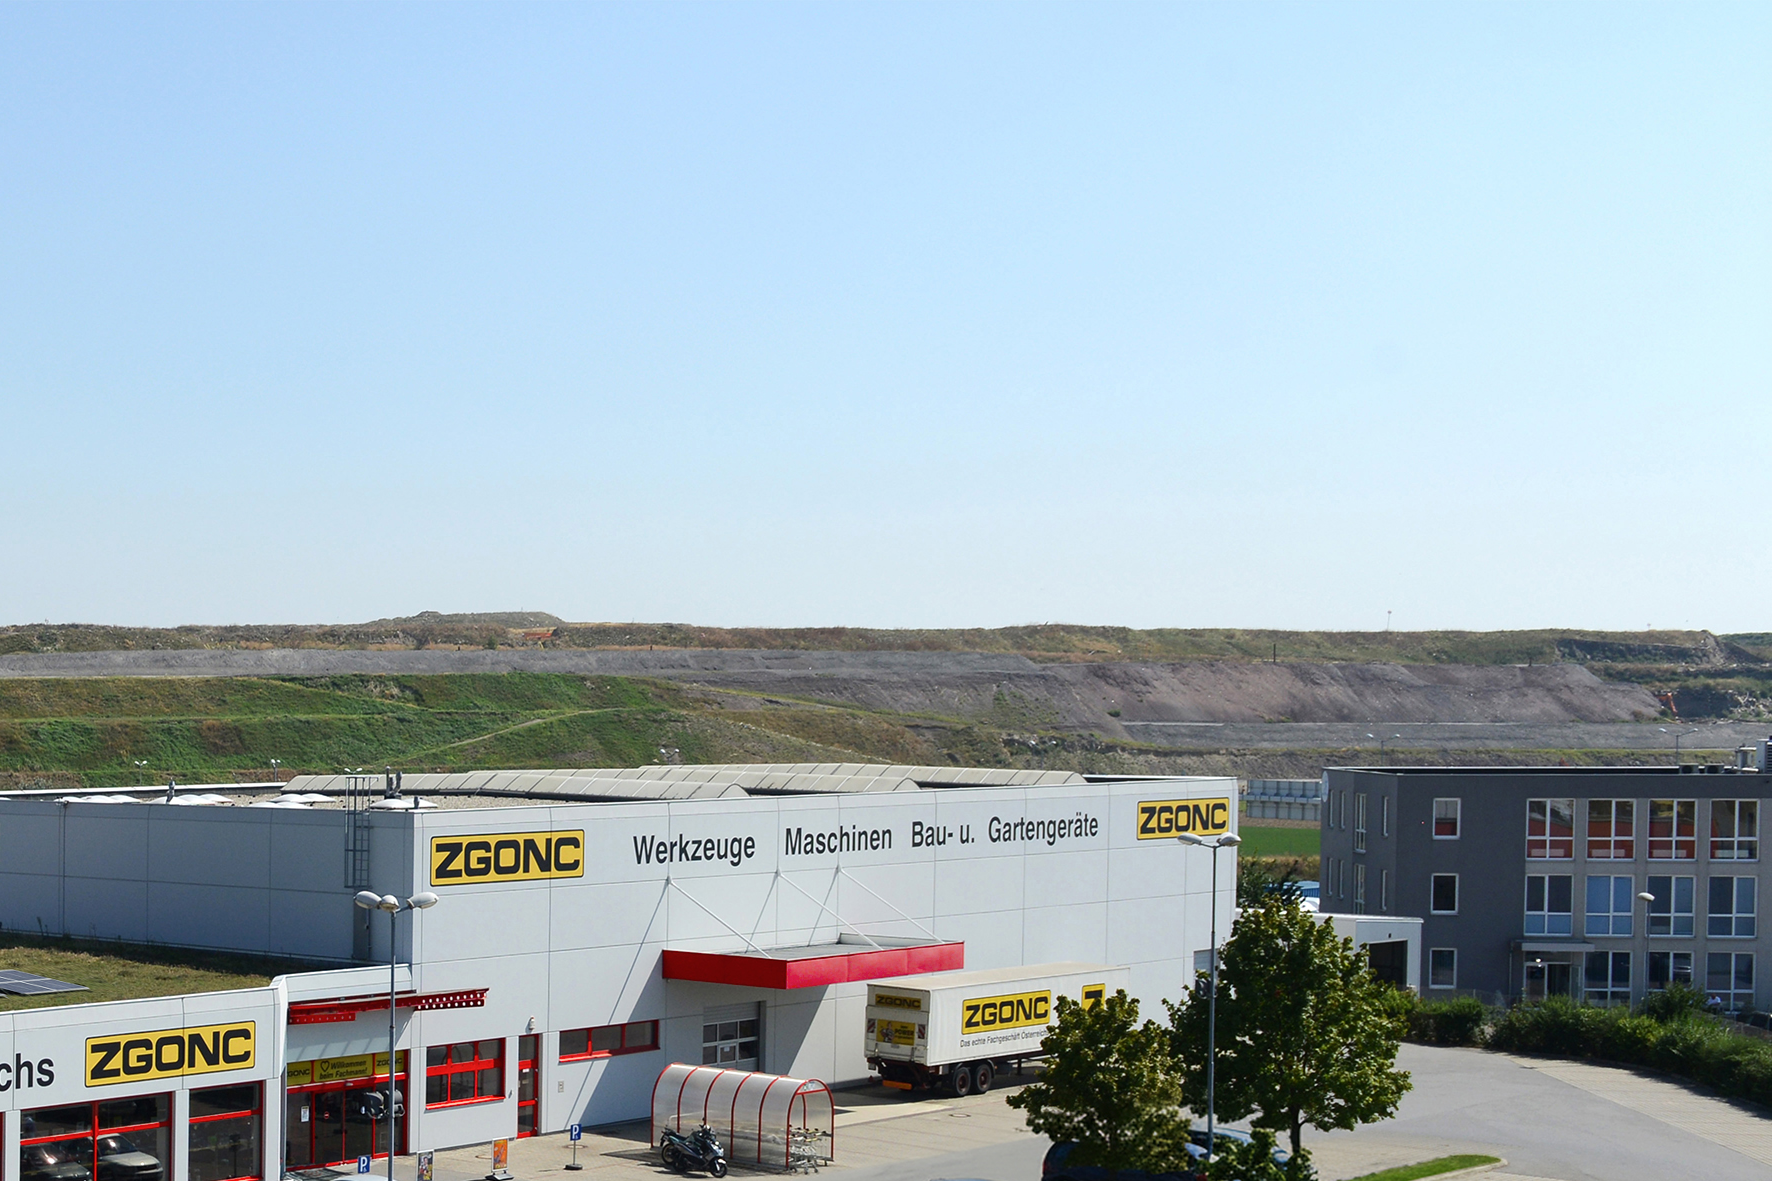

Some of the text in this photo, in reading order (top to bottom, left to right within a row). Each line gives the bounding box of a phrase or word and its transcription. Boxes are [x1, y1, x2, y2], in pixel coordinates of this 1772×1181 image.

[1140, 803, 1227, 834] ZGONC
[633, 834, 755, 867] Werkzeuge
[785, 825, 892, 856] Maschinen
[959, 824, 975, 845] u.
[988, 812, 1099, 846] Gartengeräte
[435, 836, 581, 879] ZGONC
[877, 996, 921, 1008] ZGONC
[965, 996, 1049, 1029] ZGONC
[960, 1040, 970, 1048] Das
[971, 1038, 986, 1046] echte
[987, 1033, 1020, 1044] Fachgeschäft
[90, 1028, 252, 1080] ZGONC
[331, 1060, 367, 1070] Willkommen
[287, 1069, 310, 1077] GONC
[319, 1067, 368, 1080] beim Fachmann!
[572, 1125, 579, 1140] P
[360, 1156, 367, 1172] P
